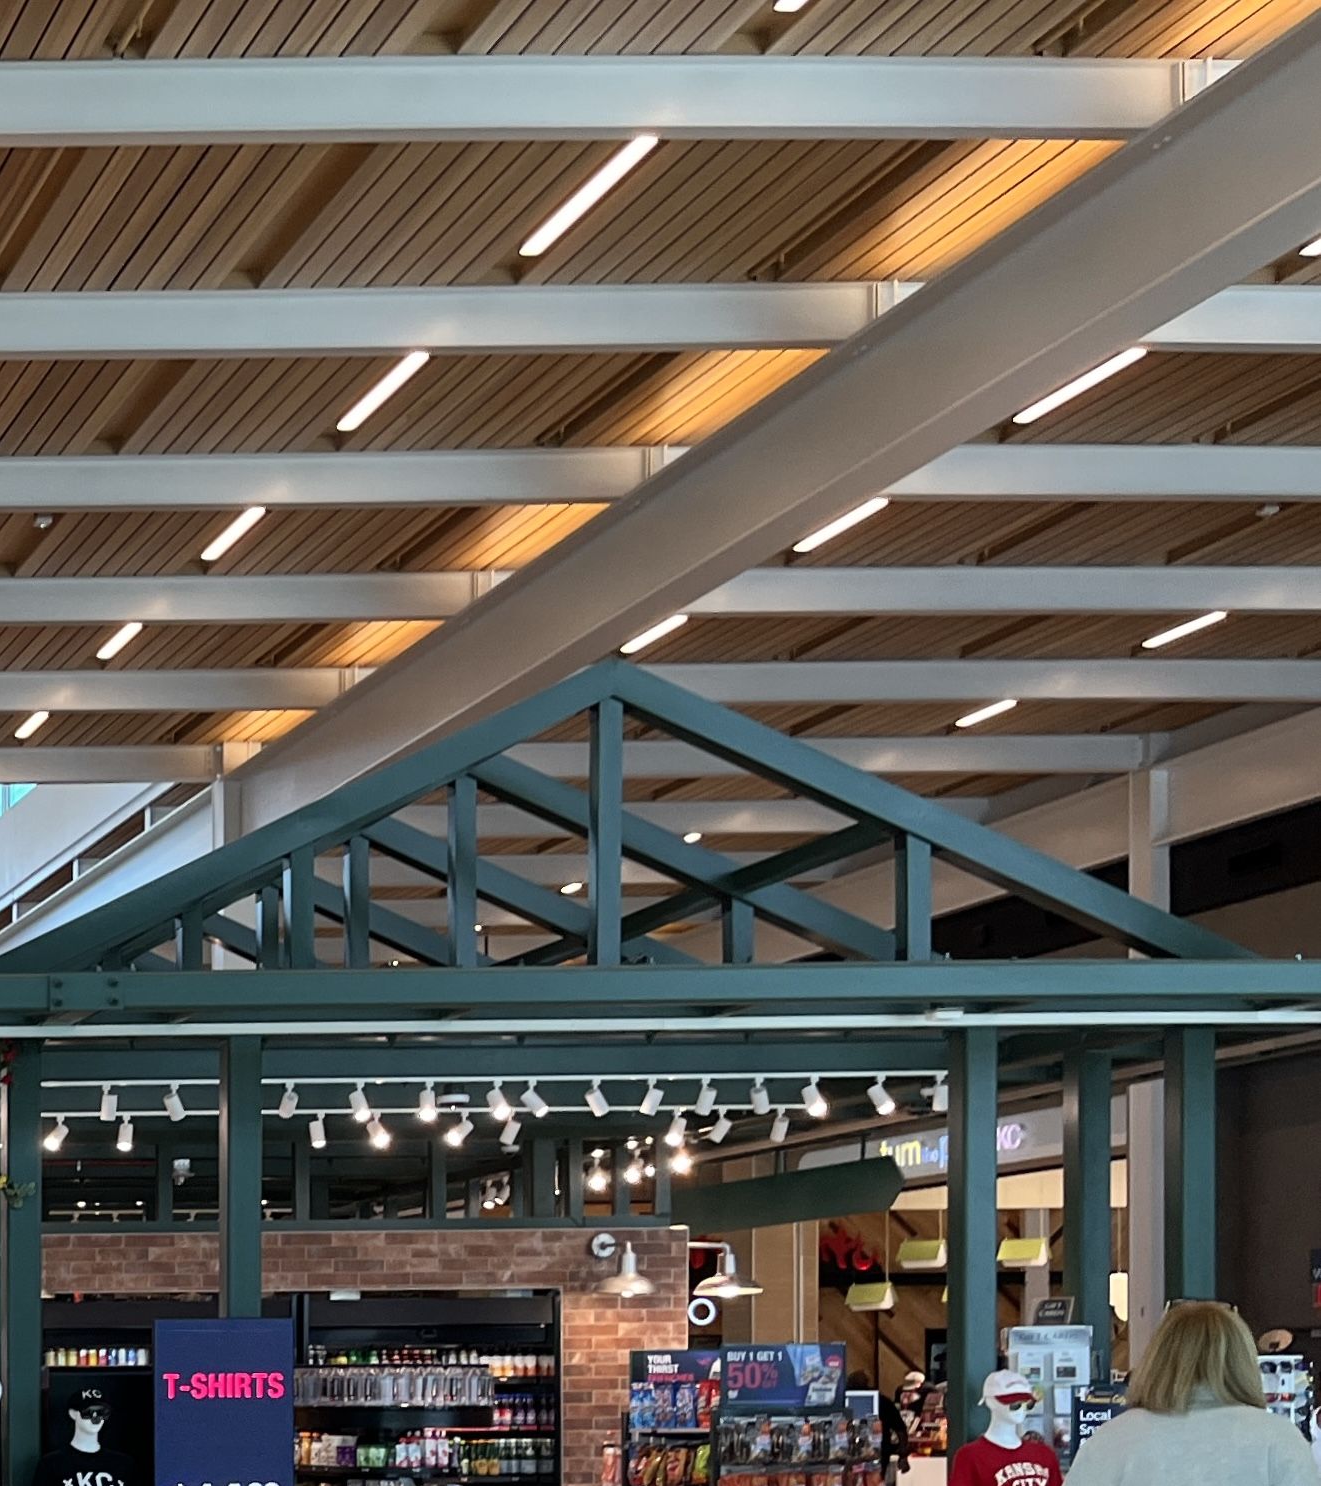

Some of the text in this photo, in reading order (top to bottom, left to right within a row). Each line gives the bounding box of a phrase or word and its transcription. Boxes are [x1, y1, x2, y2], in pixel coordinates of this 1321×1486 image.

[647, 1354, 671, 1364] YOUR
[727, 1351, 745, 1362] BUY
[757, 1351, 774, 1361] GET
[727, 1363, 779, 1389] 50%
[162, 1372, 285, 1399] T-SHIRTS
[1079, 1408, 1112, 1421] Local
